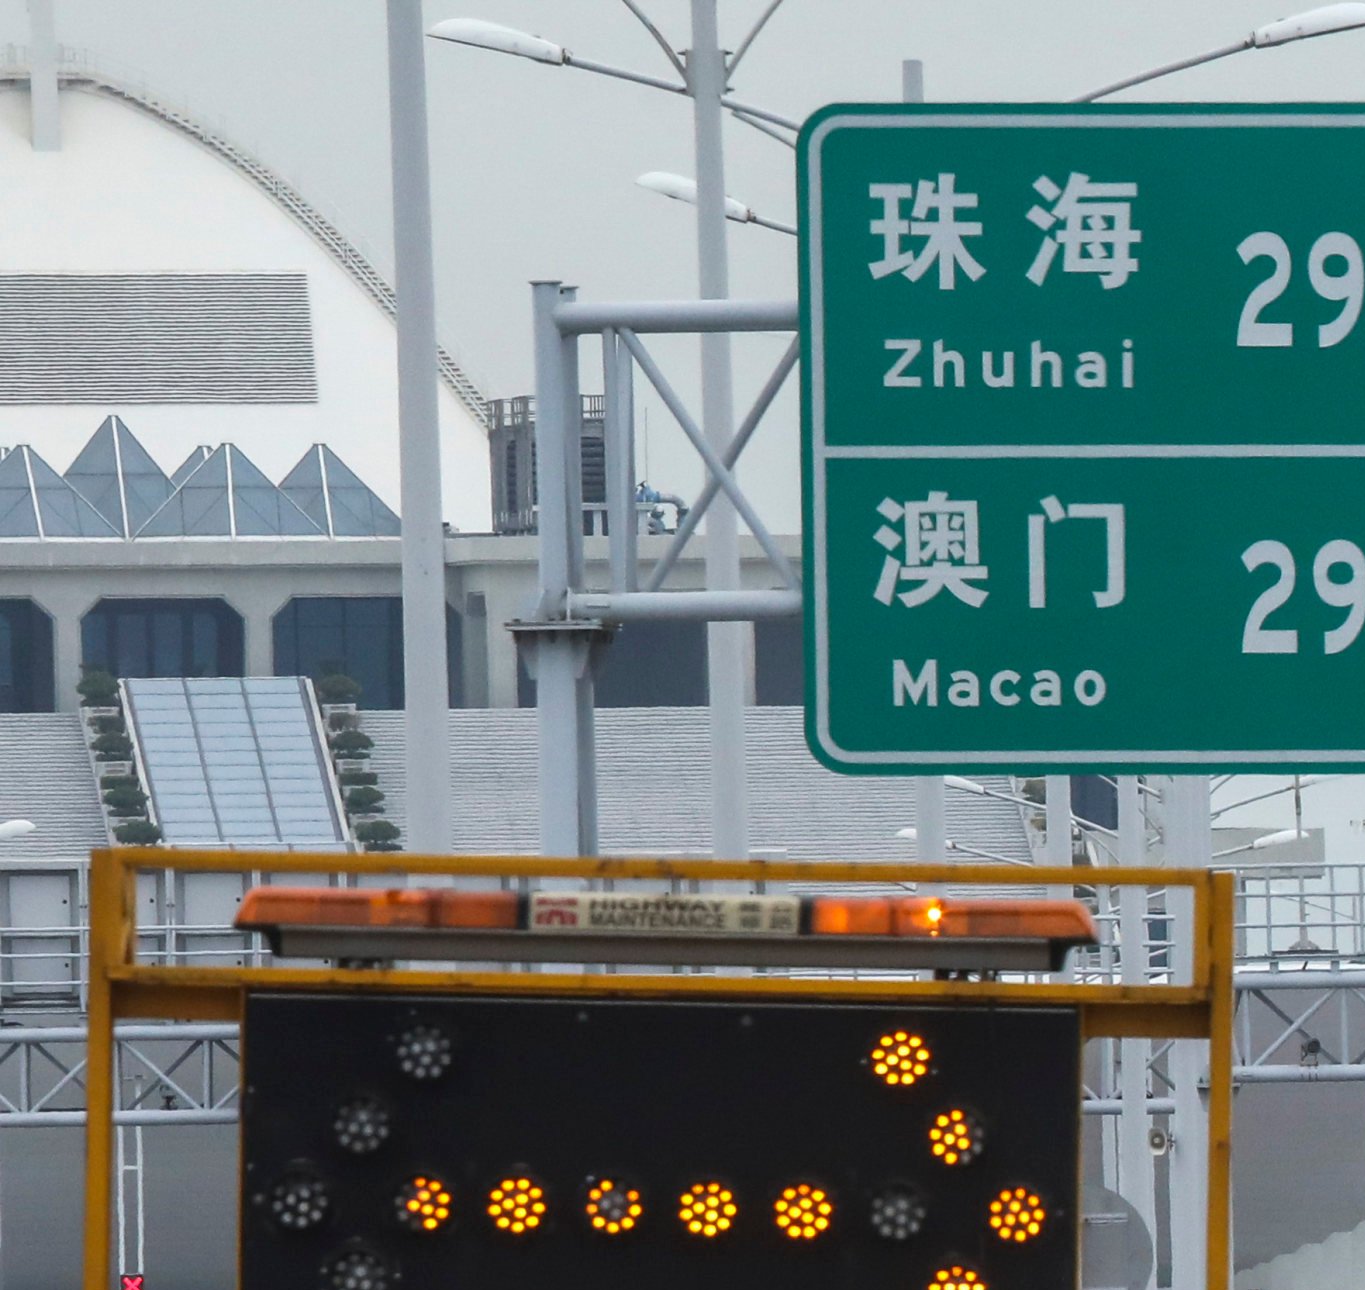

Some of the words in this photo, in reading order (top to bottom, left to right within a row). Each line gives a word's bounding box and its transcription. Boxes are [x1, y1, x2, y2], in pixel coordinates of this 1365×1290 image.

[867, 171, 1142, 290] 珠海
[882, 338, 1135, 388] Zhuhai
[872, 491, 1128, 609] 澳门
[892, 658, 1108, 707] Macao
[588, 898, 725, 912] HIGHWAY
[588, 912, 727, 929] MAINTENANCE
